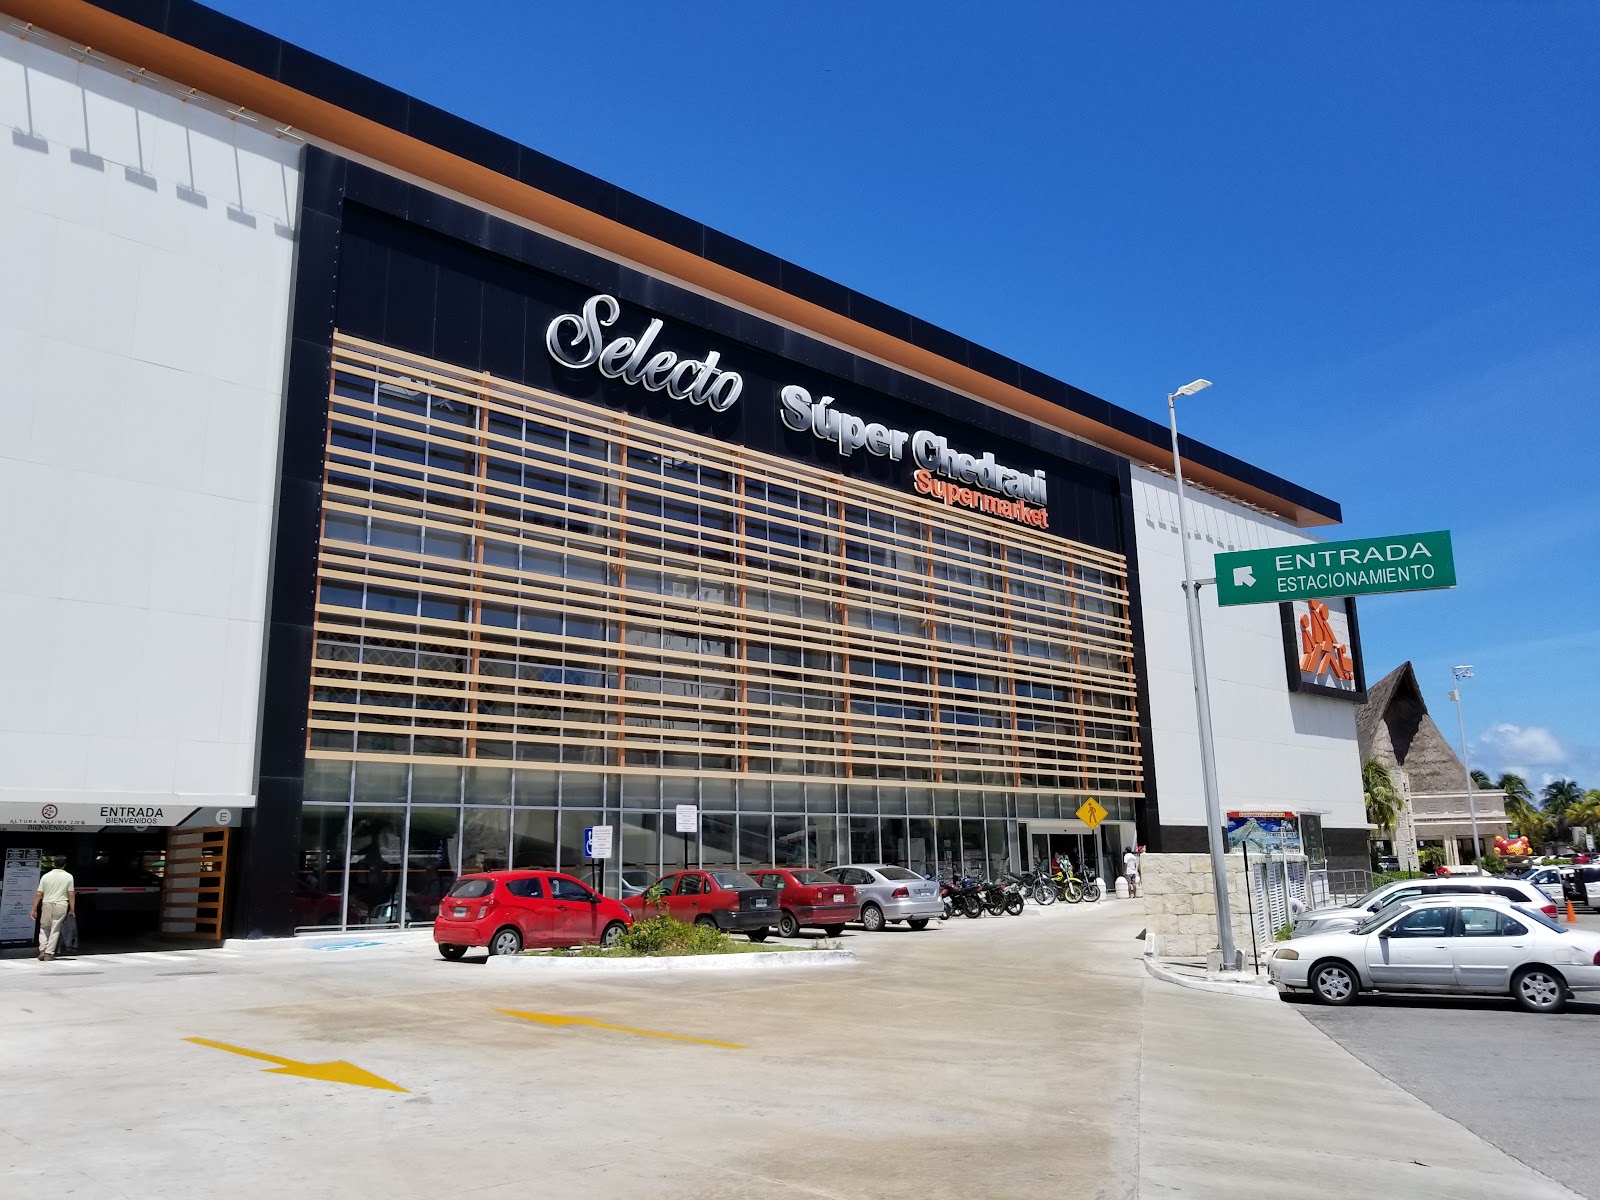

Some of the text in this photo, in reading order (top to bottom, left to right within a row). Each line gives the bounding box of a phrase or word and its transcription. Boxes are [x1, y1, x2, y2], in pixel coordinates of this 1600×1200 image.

[546, 294, 744, 413] Selecto
[780, 384, 1048, 505] Súper Chedraui
[912, 468, 1050, 529] Supermarket
[1275, 542, 1432, 571] ENTRADA
[1277, 563, 1435, 593] ESTACIONAMIENTO
[100, 806, 164, 818] ENTRADA
[105, 817, 158, 825] BIENVENIDOS
[219, 812, 228, 822] E
[28, 824, 75, 832] BIENVENIDOS
